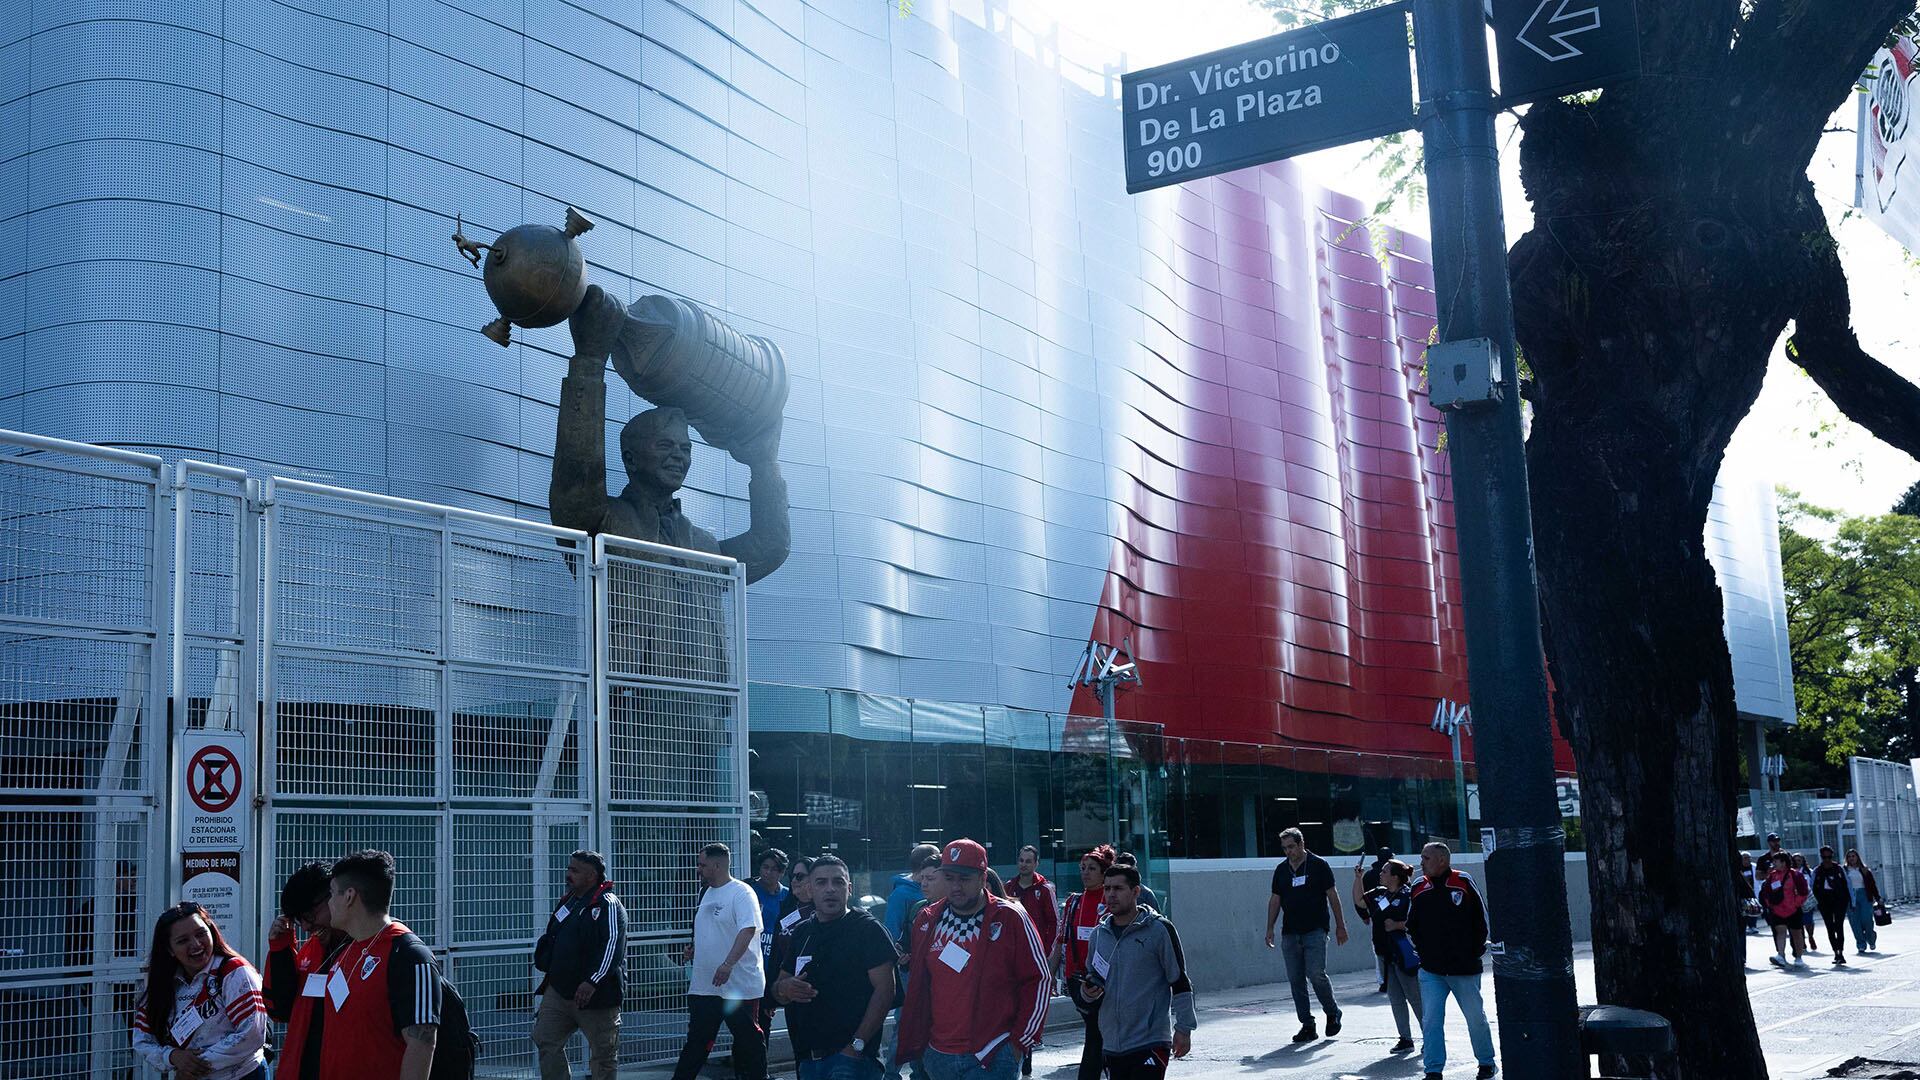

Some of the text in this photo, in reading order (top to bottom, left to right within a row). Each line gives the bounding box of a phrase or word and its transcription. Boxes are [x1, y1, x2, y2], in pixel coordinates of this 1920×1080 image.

[1136, 42, 1340, 111] Dr. Victorino
[1139, 84, 1323, 146] De La Plaza
[1147, 141, 1203, 177] 900
[195, 816, 233, 824] PROHIBIDO
[191, 826, 236, 834] ESTACIONAR
[189, 836, 238, 844] O DETENERSE
[185, 858, 237, 868] MEDIOS DE PAGO
